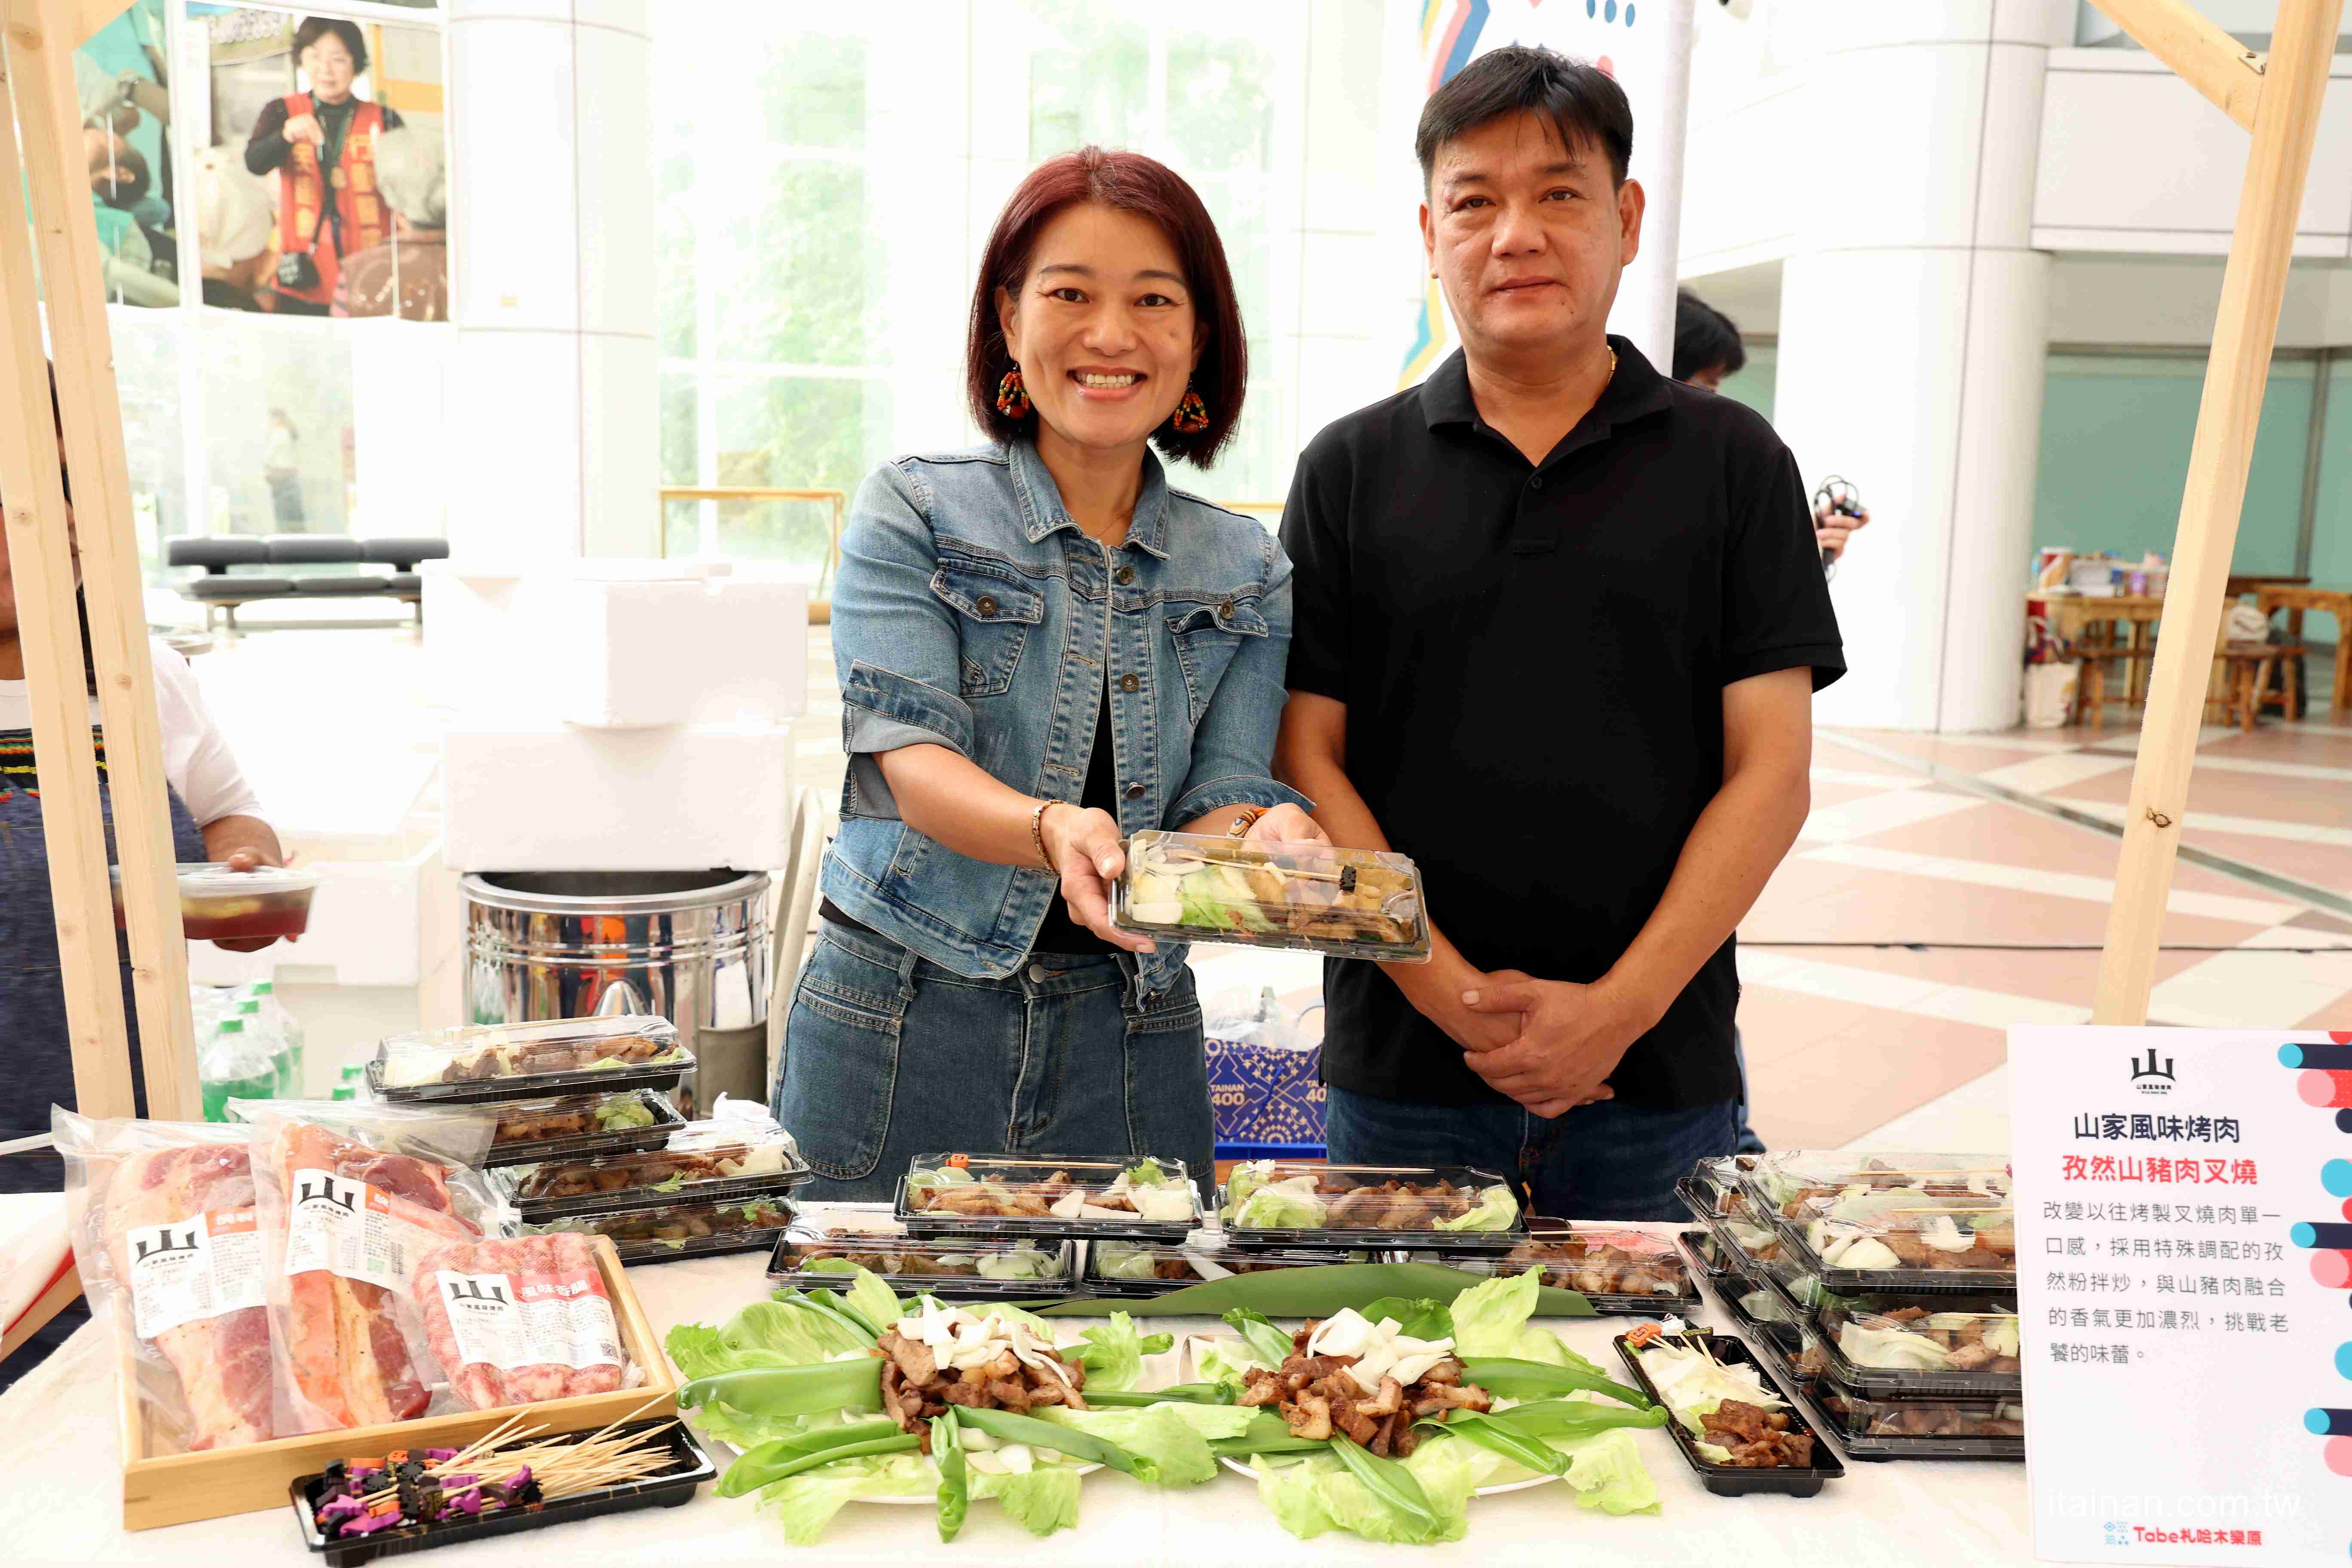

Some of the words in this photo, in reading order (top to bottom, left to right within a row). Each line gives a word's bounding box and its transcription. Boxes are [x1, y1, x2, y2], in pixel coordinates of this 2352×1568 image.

[1210, 1084, 1245, 1093] TAINAN
[1212, 1093, 1245, 1106] 400
[1306, 1088, 1327, 1102] 40
[2074, 1112, 2240, 1143] 山家風味烤肉
[2062, 1155, 2257, 1185] 孜然山豬肉叉燒
[2043, 1201, 2281, 1225] 改變以往烤製叉燒肉單一
[2046, 1237, 2284, 1261] 口感，採用特殊調配的孜
[2046, 1271, 2286, 1296] 然粉拌炒，與山豬肉融合
[2049, 1307, 2289, 1332] 的香氣更加濃烈，挑戰老
[2050, 1343, 2144, 1364] 饕的味蕾。
[2133, 1526, 2263, 1546] Tabe札哈木樂原
